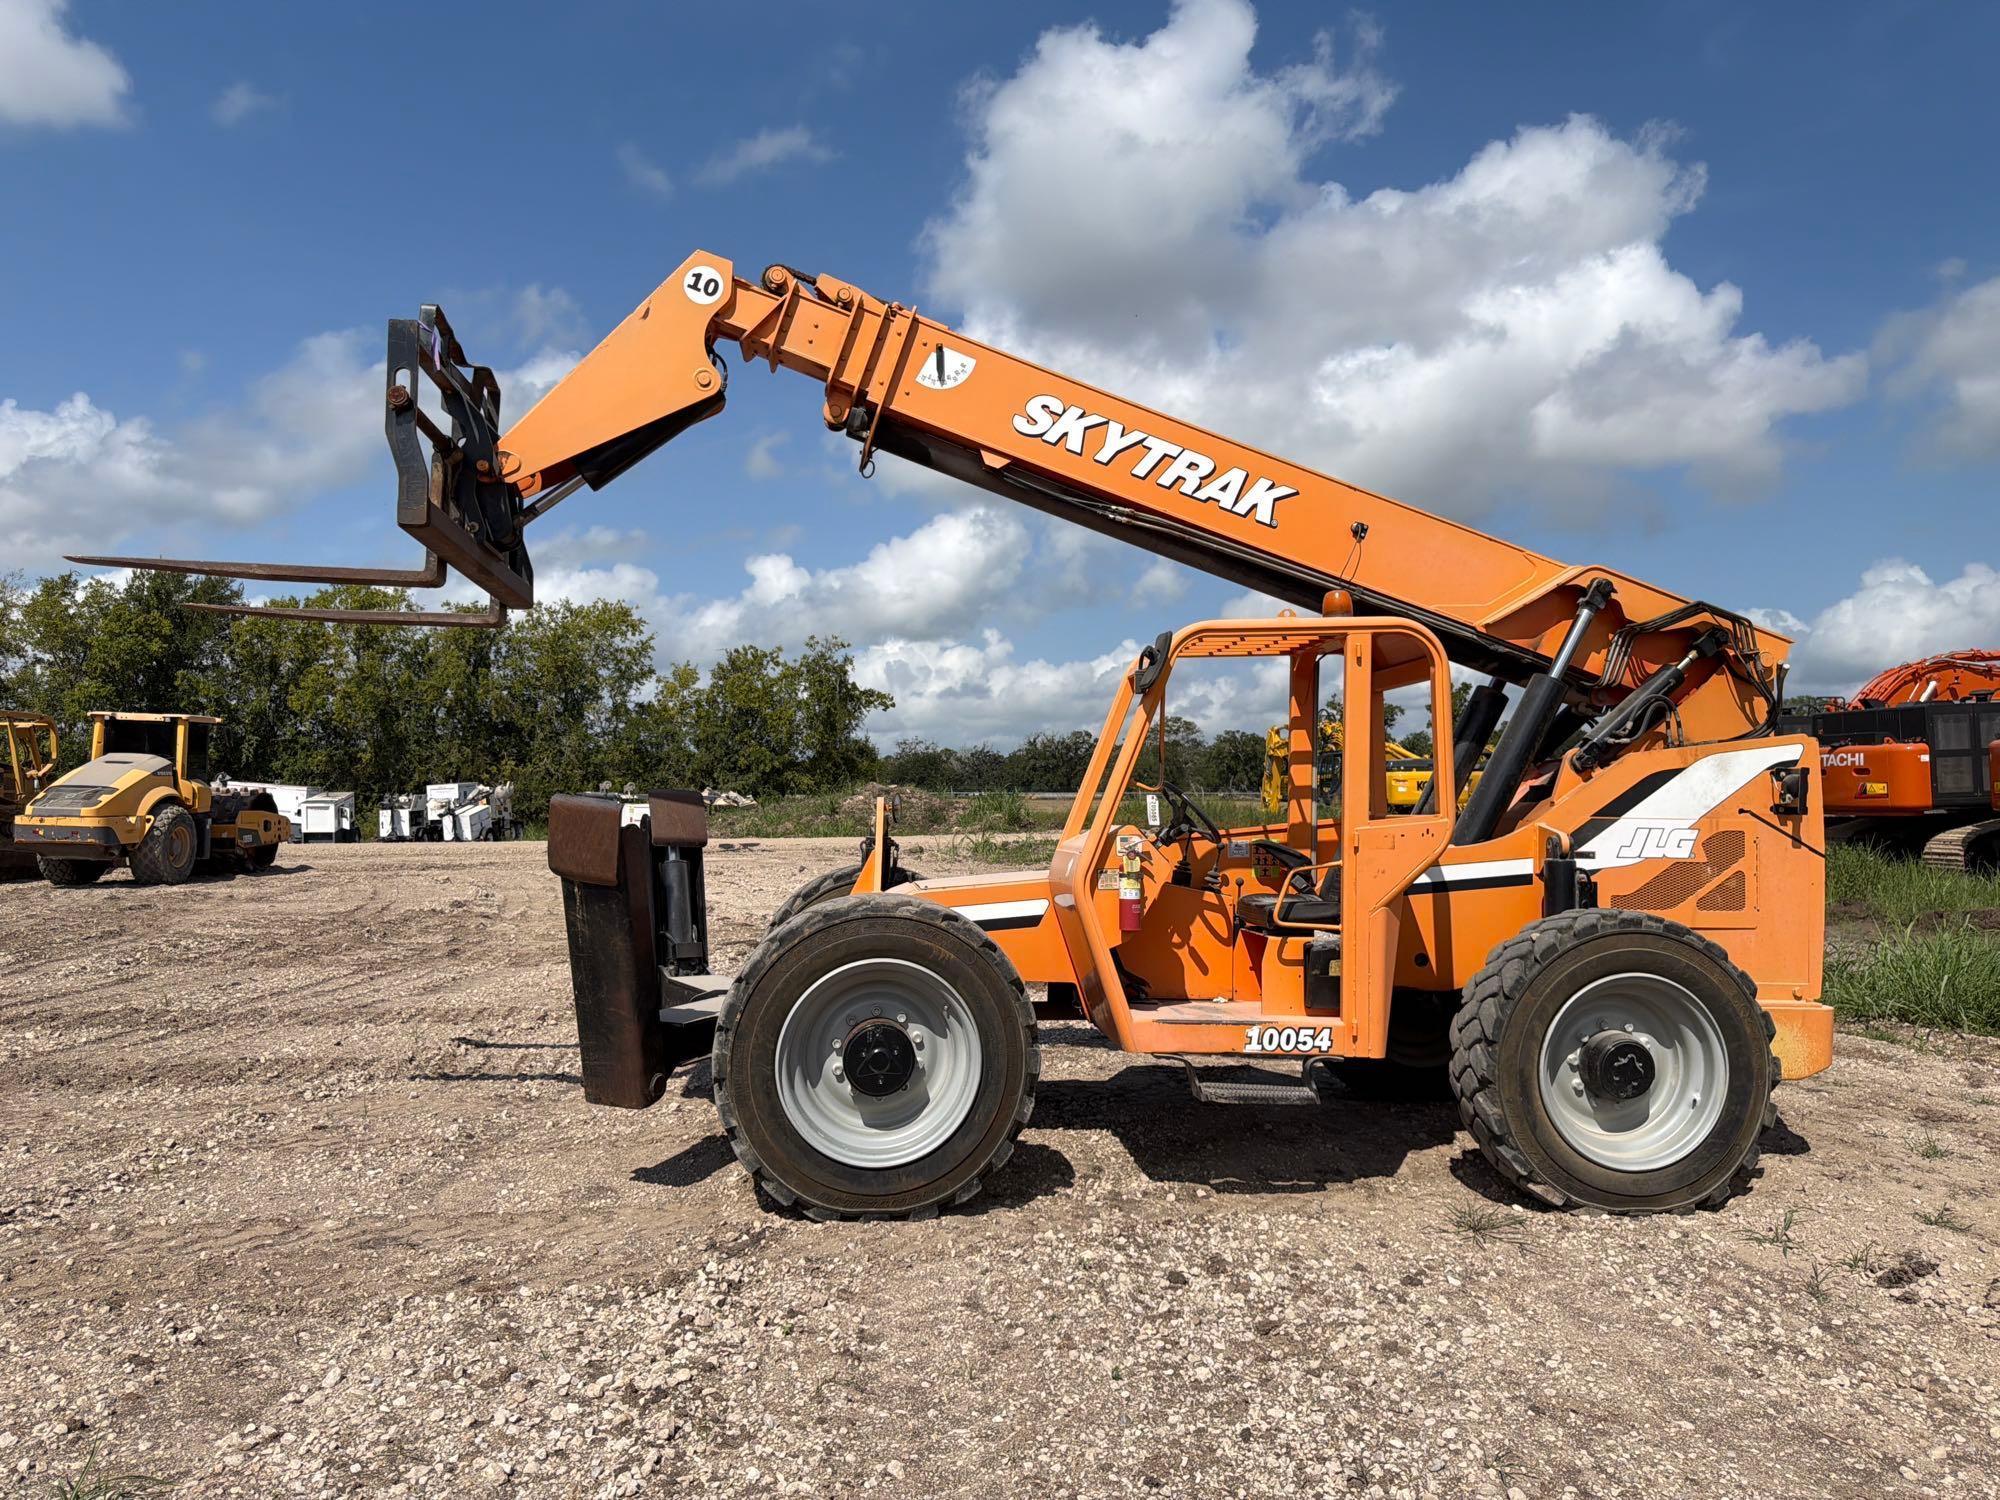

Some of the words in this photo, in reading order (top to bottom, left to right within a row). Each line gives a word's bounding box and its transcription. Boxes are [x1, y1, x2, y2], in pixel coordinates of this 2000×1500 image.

[687, 272, 719, 297] 10
[1012, 394, 1299, 527] SKYTRAK
[1616, 827, 1700, 859] JLG
[1244, 1026, 1333, 1053] 10054
